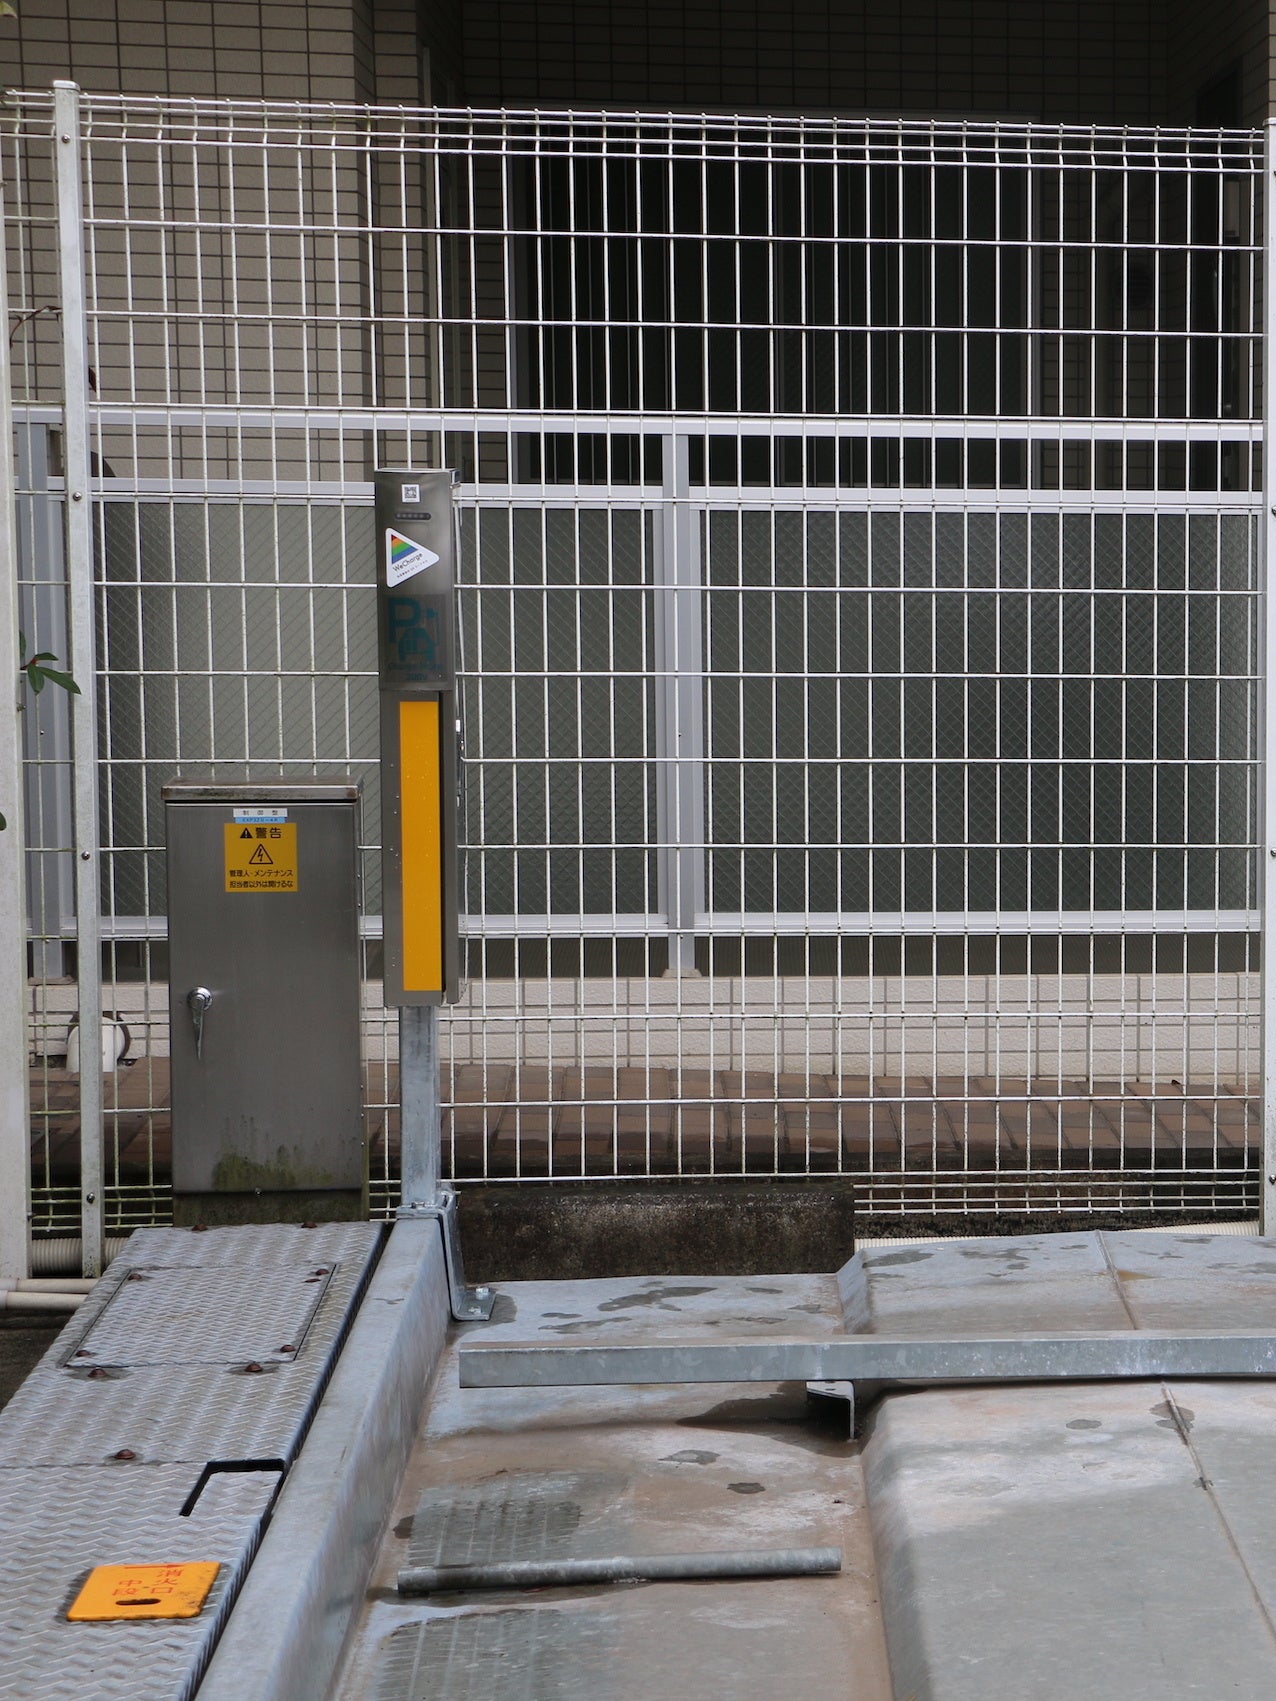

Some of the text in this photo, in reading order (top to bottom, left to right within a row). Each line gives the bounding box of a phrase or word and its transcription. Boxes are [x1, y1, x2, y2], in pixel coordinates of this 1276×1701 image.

[393, 552, 423, 572] WeCharge
[388, 597, 421, 645] P
[255, 827, 282, 839] 警告
[229, 880, 293, 888] 担当者以外は開けるな
[151, 1569, 184, 1594] 消火口
